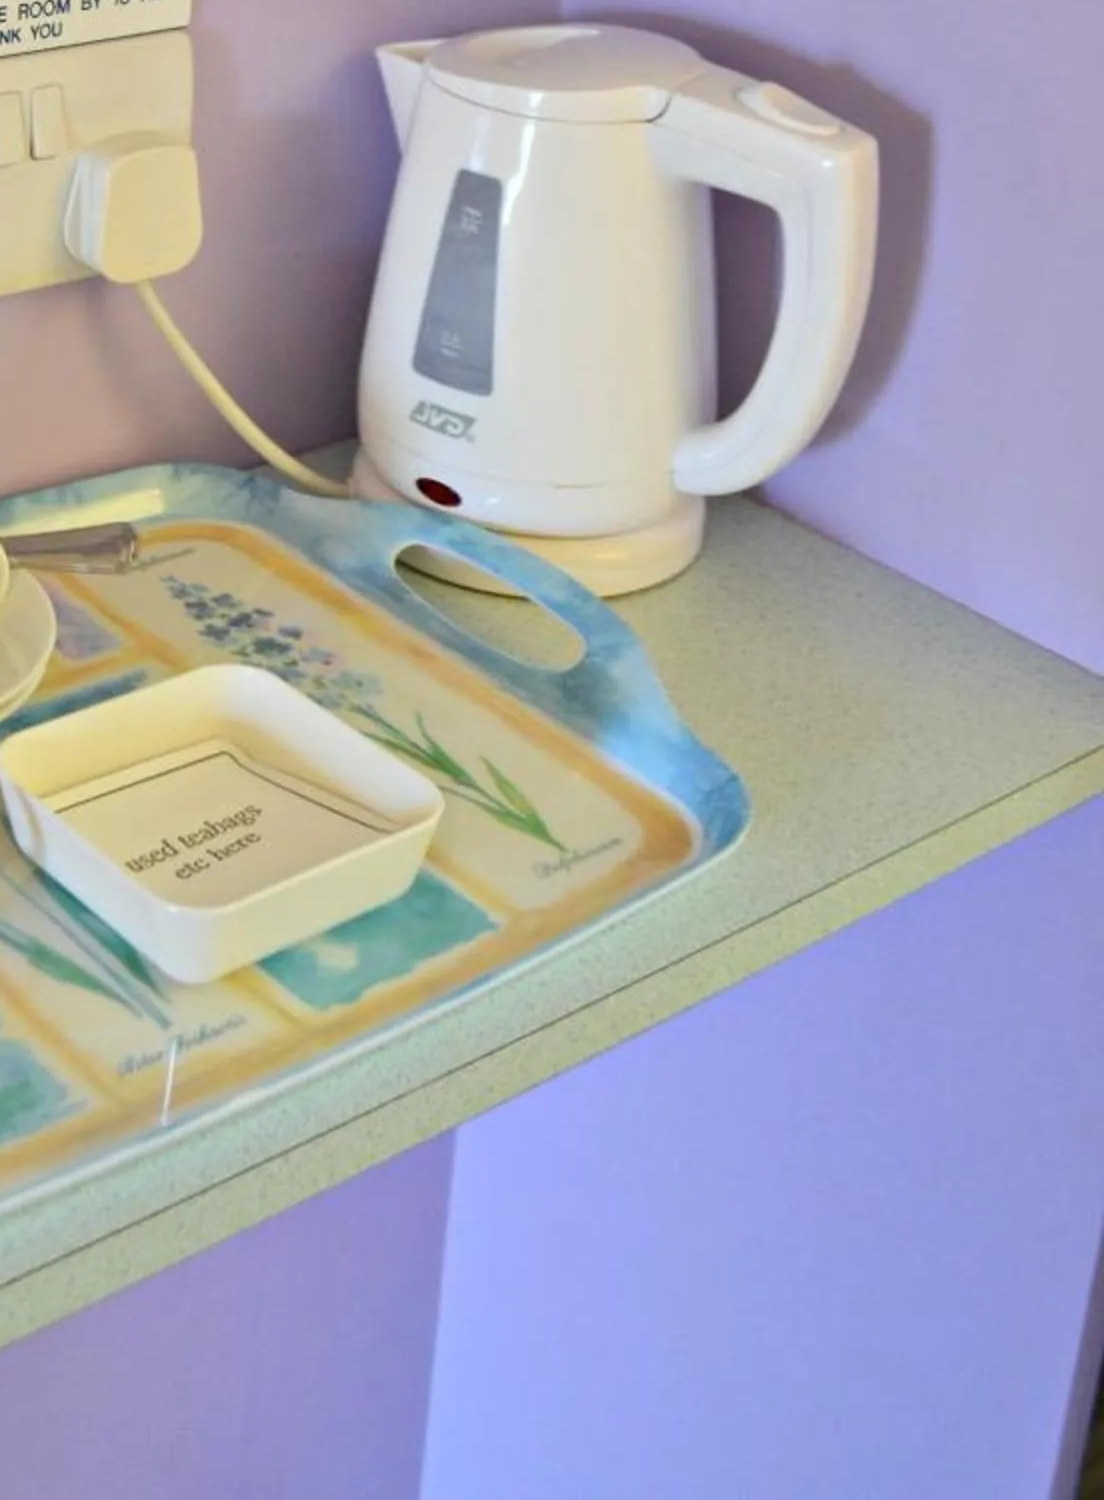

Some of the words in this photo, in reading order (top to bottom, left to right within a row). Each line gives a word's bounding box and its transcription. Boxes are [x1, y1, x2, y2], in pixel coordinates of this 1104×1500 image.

[18, 0, 70, 19] ROOM
[31, 23, 62, 38] YOU
[125, 838, 178, 872] used
[178, 805, 262, 848] teabags
[175, 858, 210, 880] etc
[206, 832, 262, 861] here
